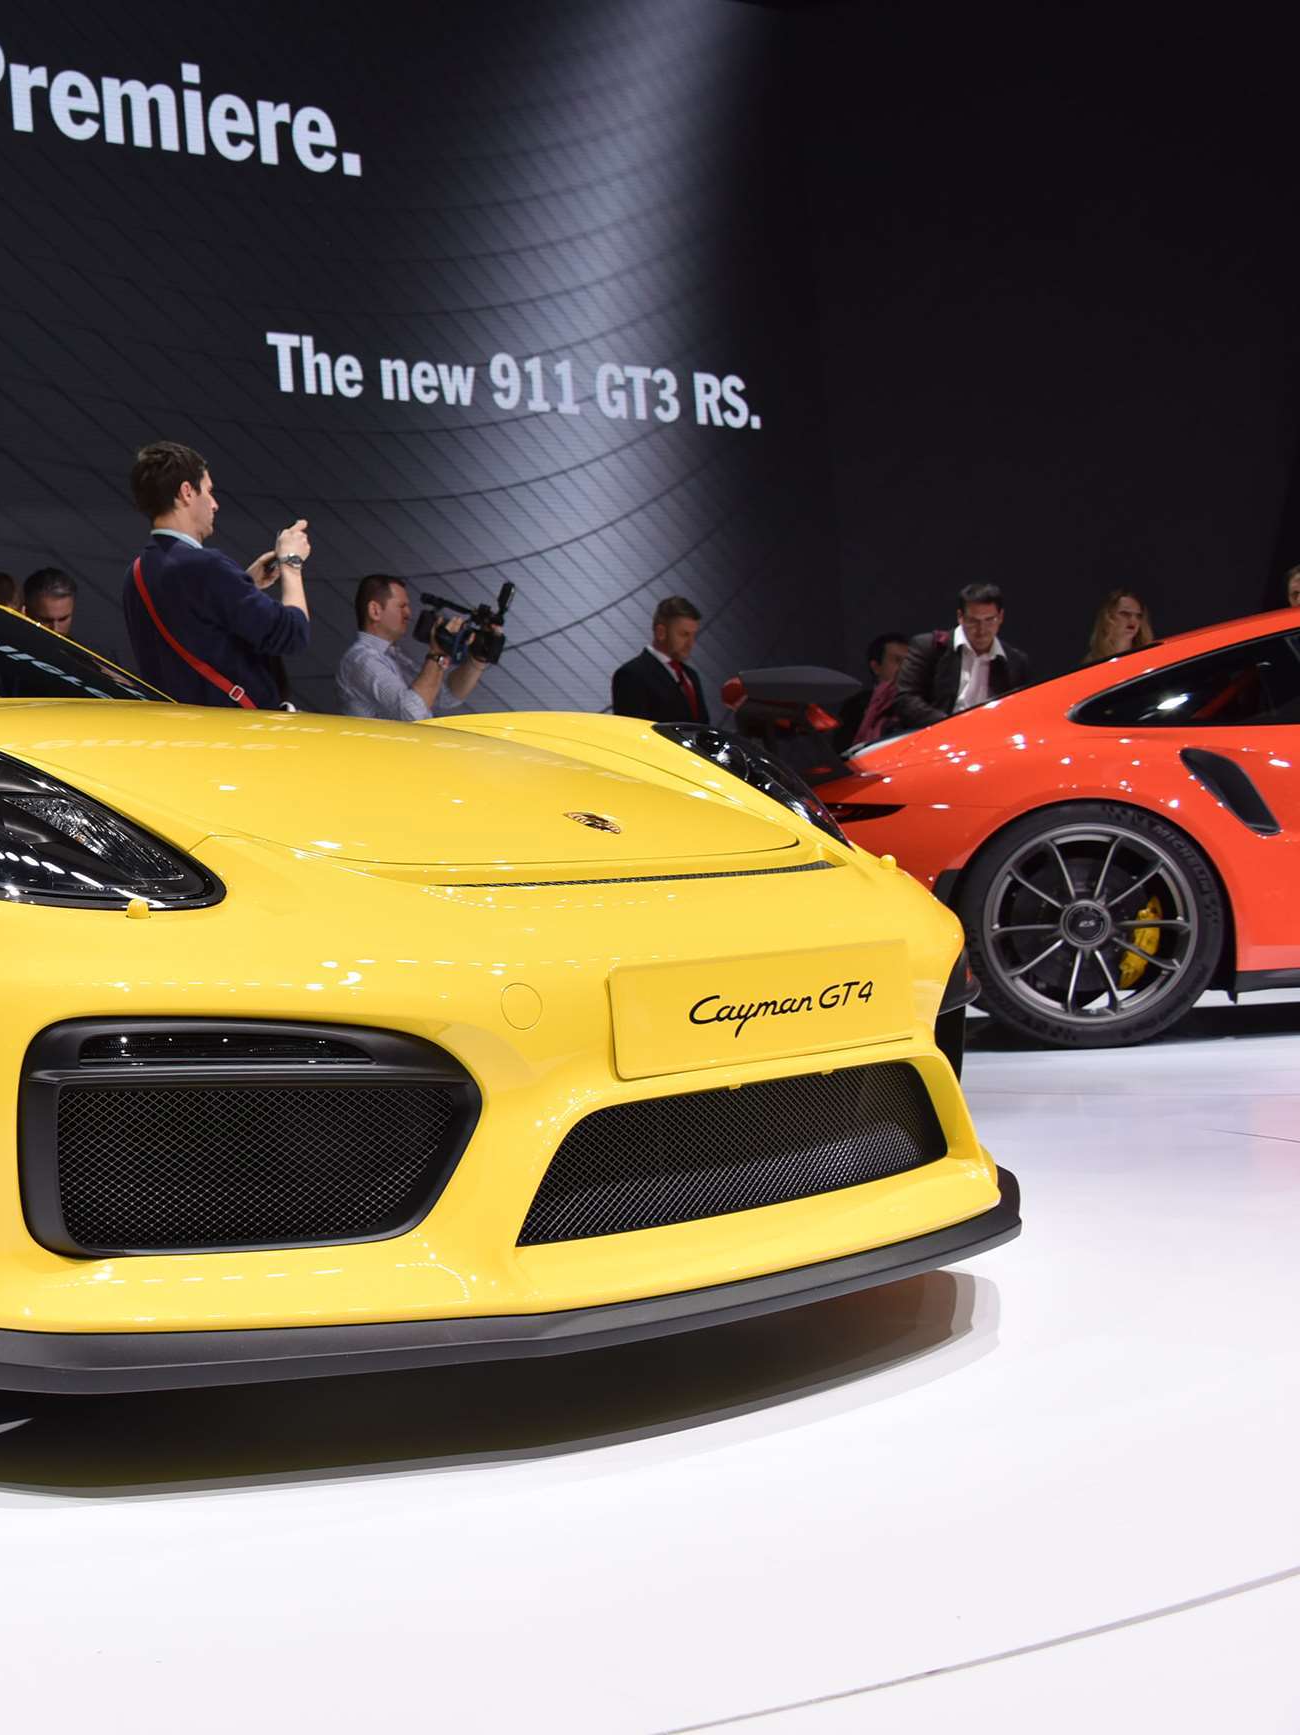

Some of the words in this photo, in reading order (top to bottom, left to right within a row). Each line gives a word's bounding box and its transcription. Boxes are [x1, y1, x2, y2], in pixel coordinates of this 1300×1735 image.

[266, 332, 363, 399] The
[381, 358, 475, 407] new
[489, 353, 582, 416] 911
[594, 361, 680, 424] GT3
[693, 372, 762, 430] RS.
[688, 994, 813, 1038] Cayman
[818, 980, 875, 1009] GT4
